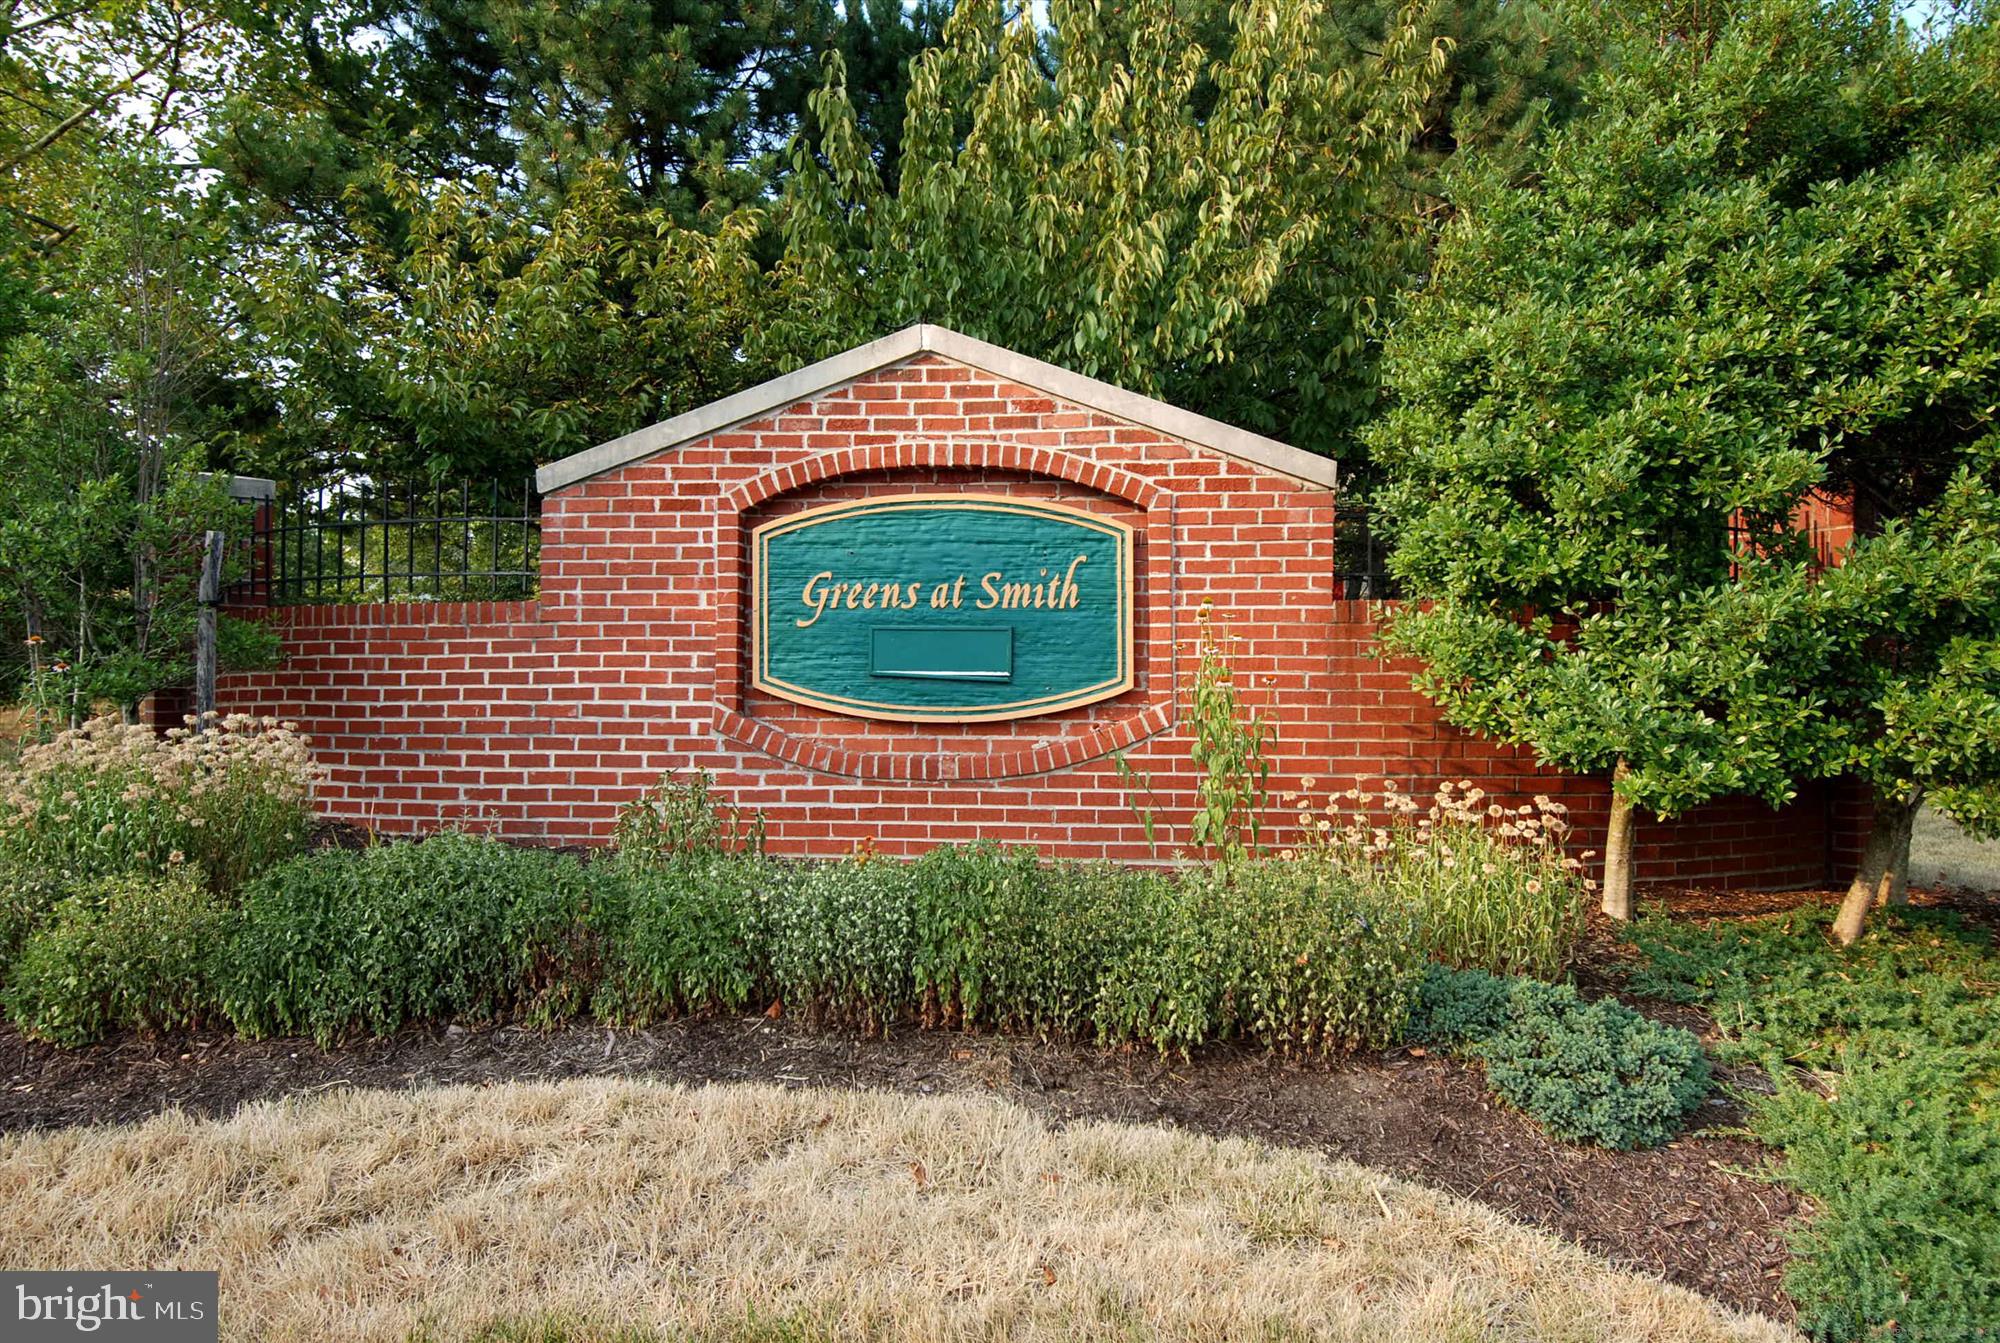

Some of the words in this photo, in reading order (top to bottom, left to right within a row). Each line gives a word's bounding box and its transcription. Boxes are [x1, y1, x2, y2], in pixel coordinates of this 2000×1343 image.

[796, 571, 921, 628] Greens
[930, 574, 966, 609] at
[976, 555, 1087, 609] Smith
